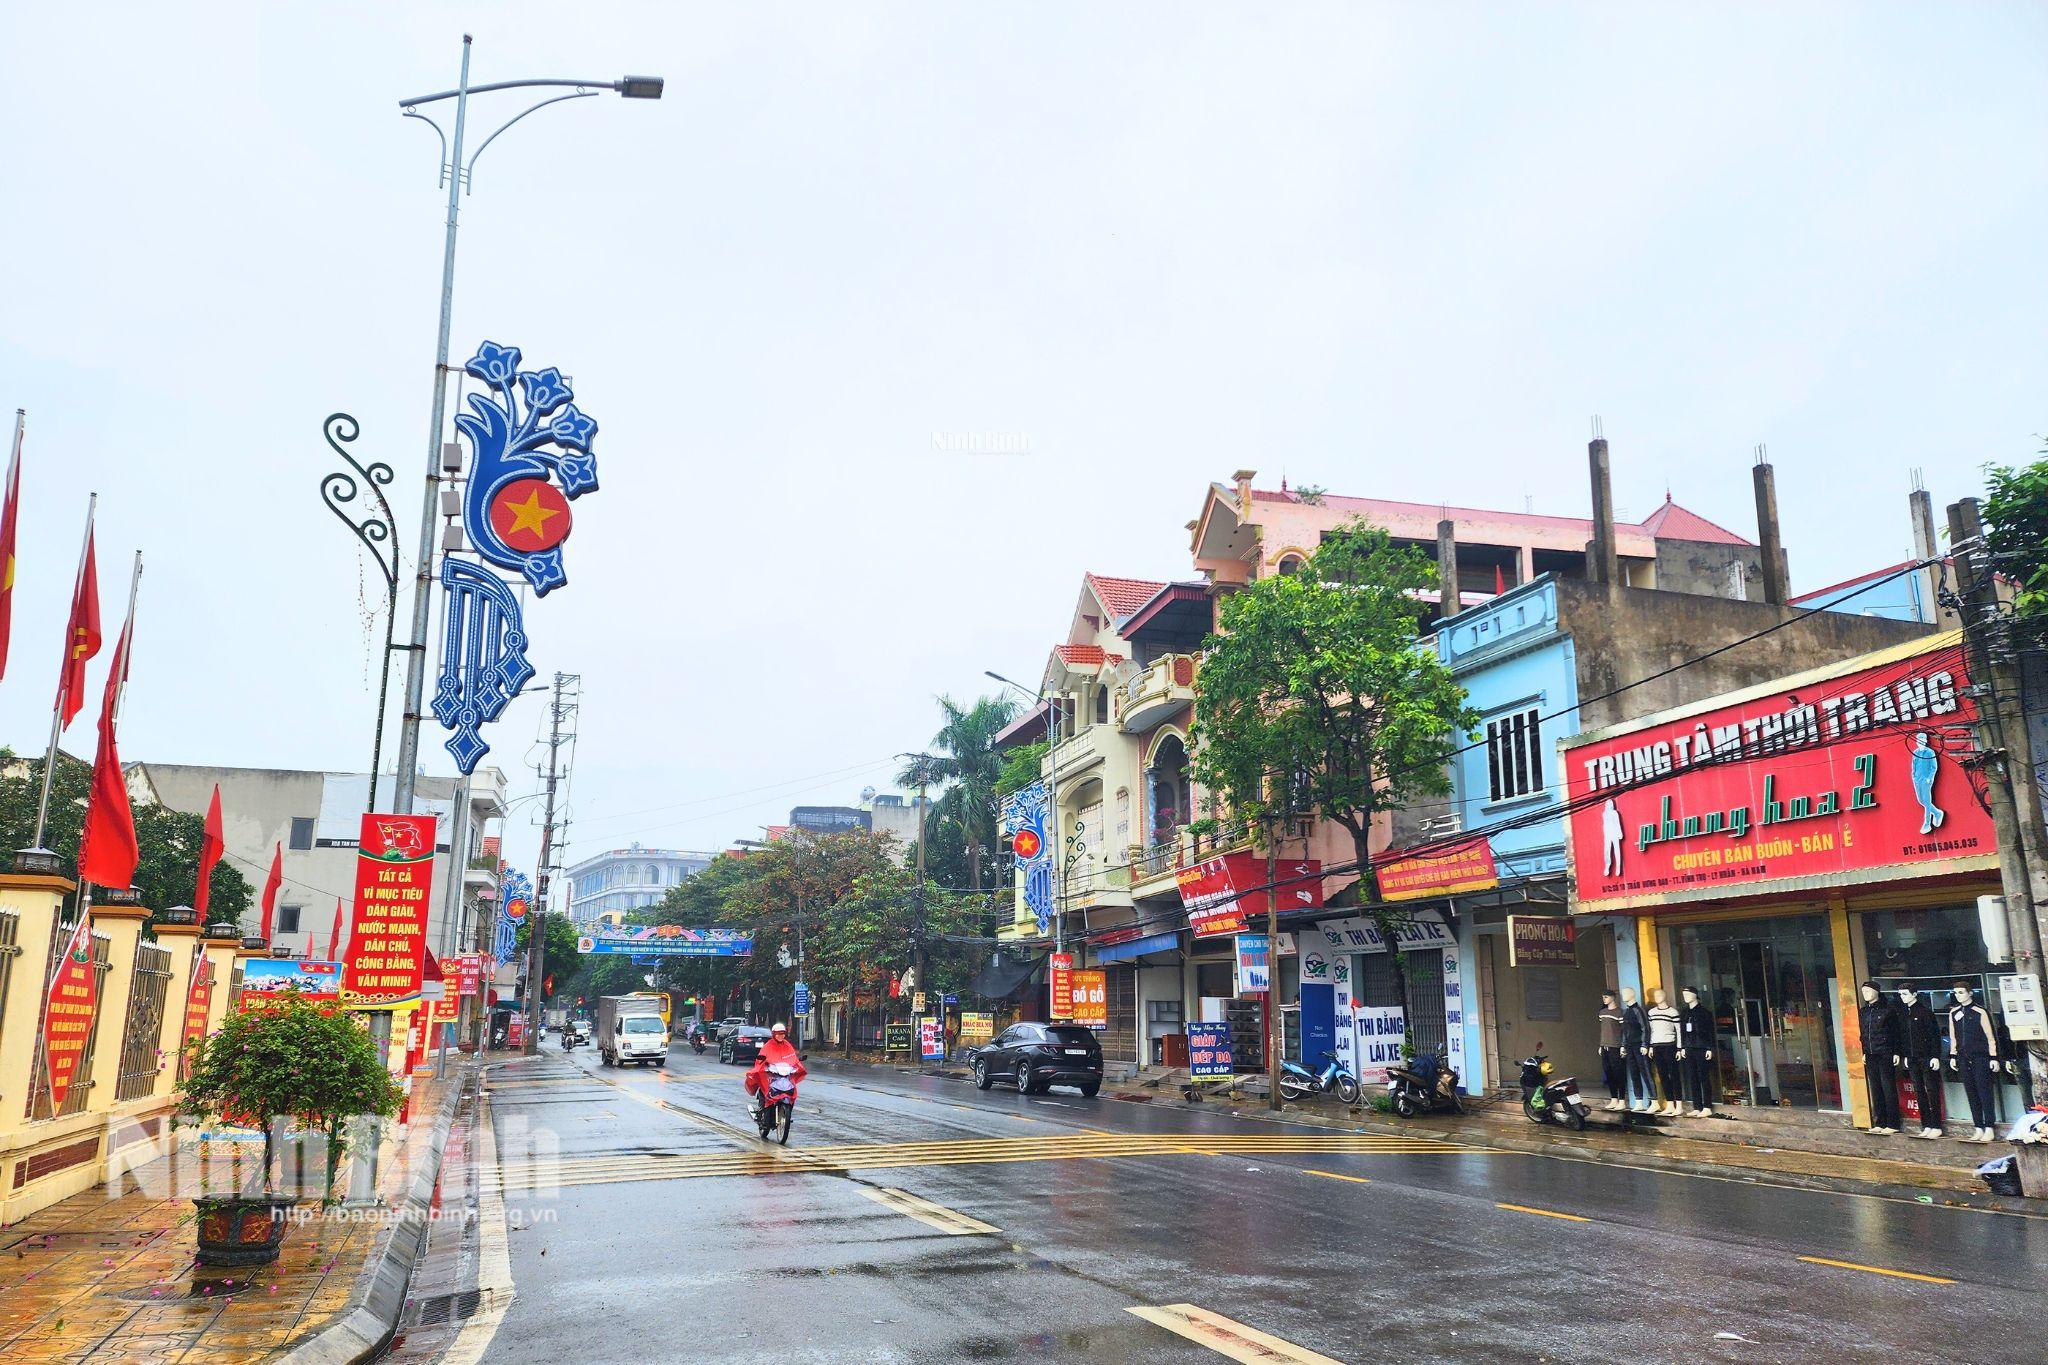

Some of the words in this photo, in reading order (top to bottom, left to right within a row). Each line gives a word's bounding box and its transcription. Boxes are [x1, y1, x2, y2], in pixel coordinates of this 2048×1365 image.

[1584, 741, 1673, 792] TRUNG
[1674, 723, 1743, 766] TÂM
[1743, 695, 1820, 756] THỜI
[1821, 671, 1958, 739] TRANG
[1634, 794, 1752, 852] phong
[1758, 774, 1839, 826] hoa
[1846, 752, 1877, 812] 2
[1673, 847, 1721, 871] CHUYÊN
[1725, 842, 1753, 865] BÁN
[378, 867, 397, 882] TẤT
[398, 867, 412, 883] CẢ
[363, 886, 374, 899] VÌ
[376, 888, 399, 901] MỤC
[402, 887, 424, 900] TIÊU
[366, 903, 388, 917] DÂN
[390, 904, 416, 918] GIÀU,
[358, 920, 386, 934] NƯỚC
[388, 922, 421, 937] MẠNH,
[1345, 930, 1368, 946] THI
[1366, 921, 1403, 944] BẰG
[1422, 922, 1446, 940] XE
[1515, 922, 1547, 941] PHONG
[1548, 924, 1568, 942] HOA
[364, 938, 386, 952] DÂN
[388, 936, 411, 953] CHỦ,
[355, 956, 384, 969] CÔNG
[386, 953, 416, 971] BẰNG,
[357, 973, 378, 987] VĂN
[380, 975, 412, 987] MINH!
[1089, 983, 1104, 1003] GỖ
[1338, 992, 1348, 1006] THI
[1073, 1008, 1088, 1018] CAO
[1090, 1005, 1105, 1018] CẤP
[1358, 1018, 1375, 1036] THI
[1377, 1010, 1404, 1036] BẰNG
[1191, 1032, 1217, 1047] GIÀY
[1216, 1051, 1232, 1064] DA
[1369, 1041, 1385, 1062] LÁI
[1387, 1043, 1401, 1062] XE
